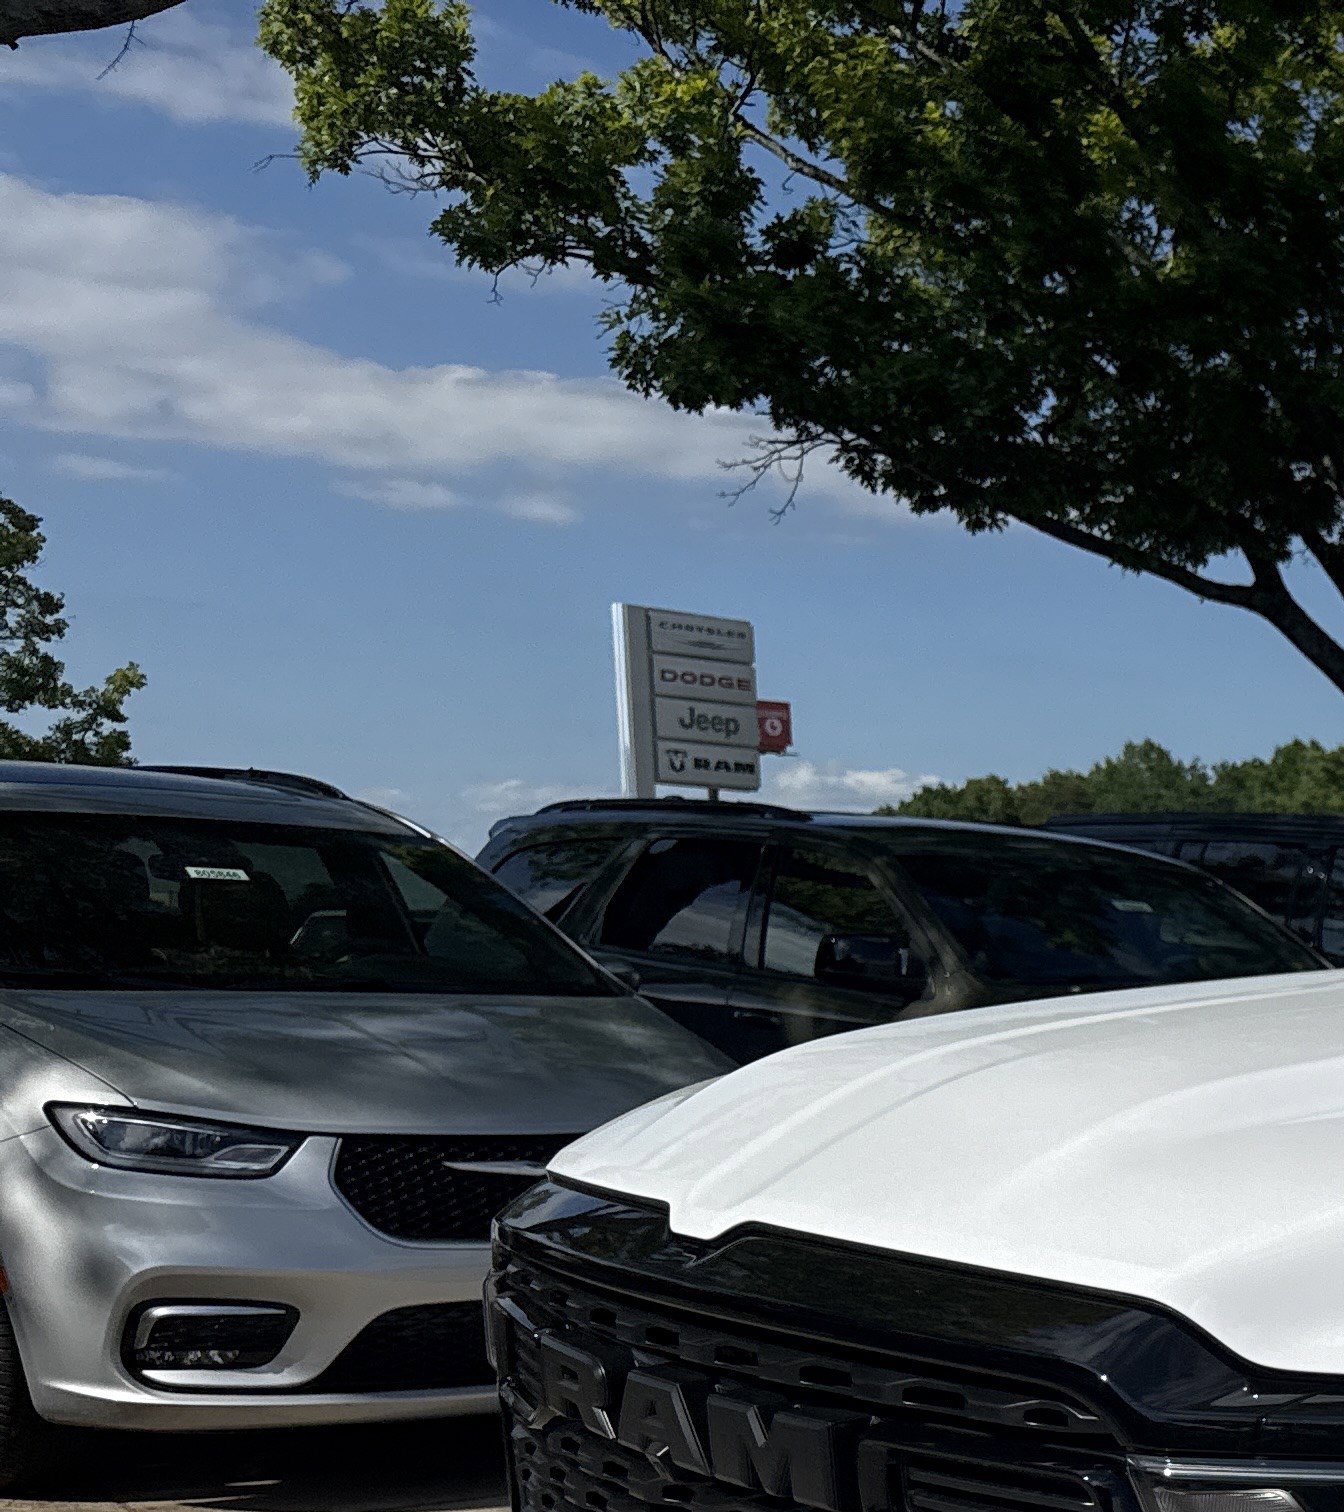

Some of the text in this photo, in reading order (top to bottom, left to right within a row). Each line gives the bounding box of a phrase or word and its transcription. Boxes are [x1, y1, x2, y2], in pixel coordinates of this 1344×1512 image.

[659, 621, 747, 640] CHRYSLER
[659, 668, 752, 692] DODGE
[677, 706, 741, 739] Jeep
[693, 756, 756, 776] RAM
[541, 1328, 864, 1512] RAM
